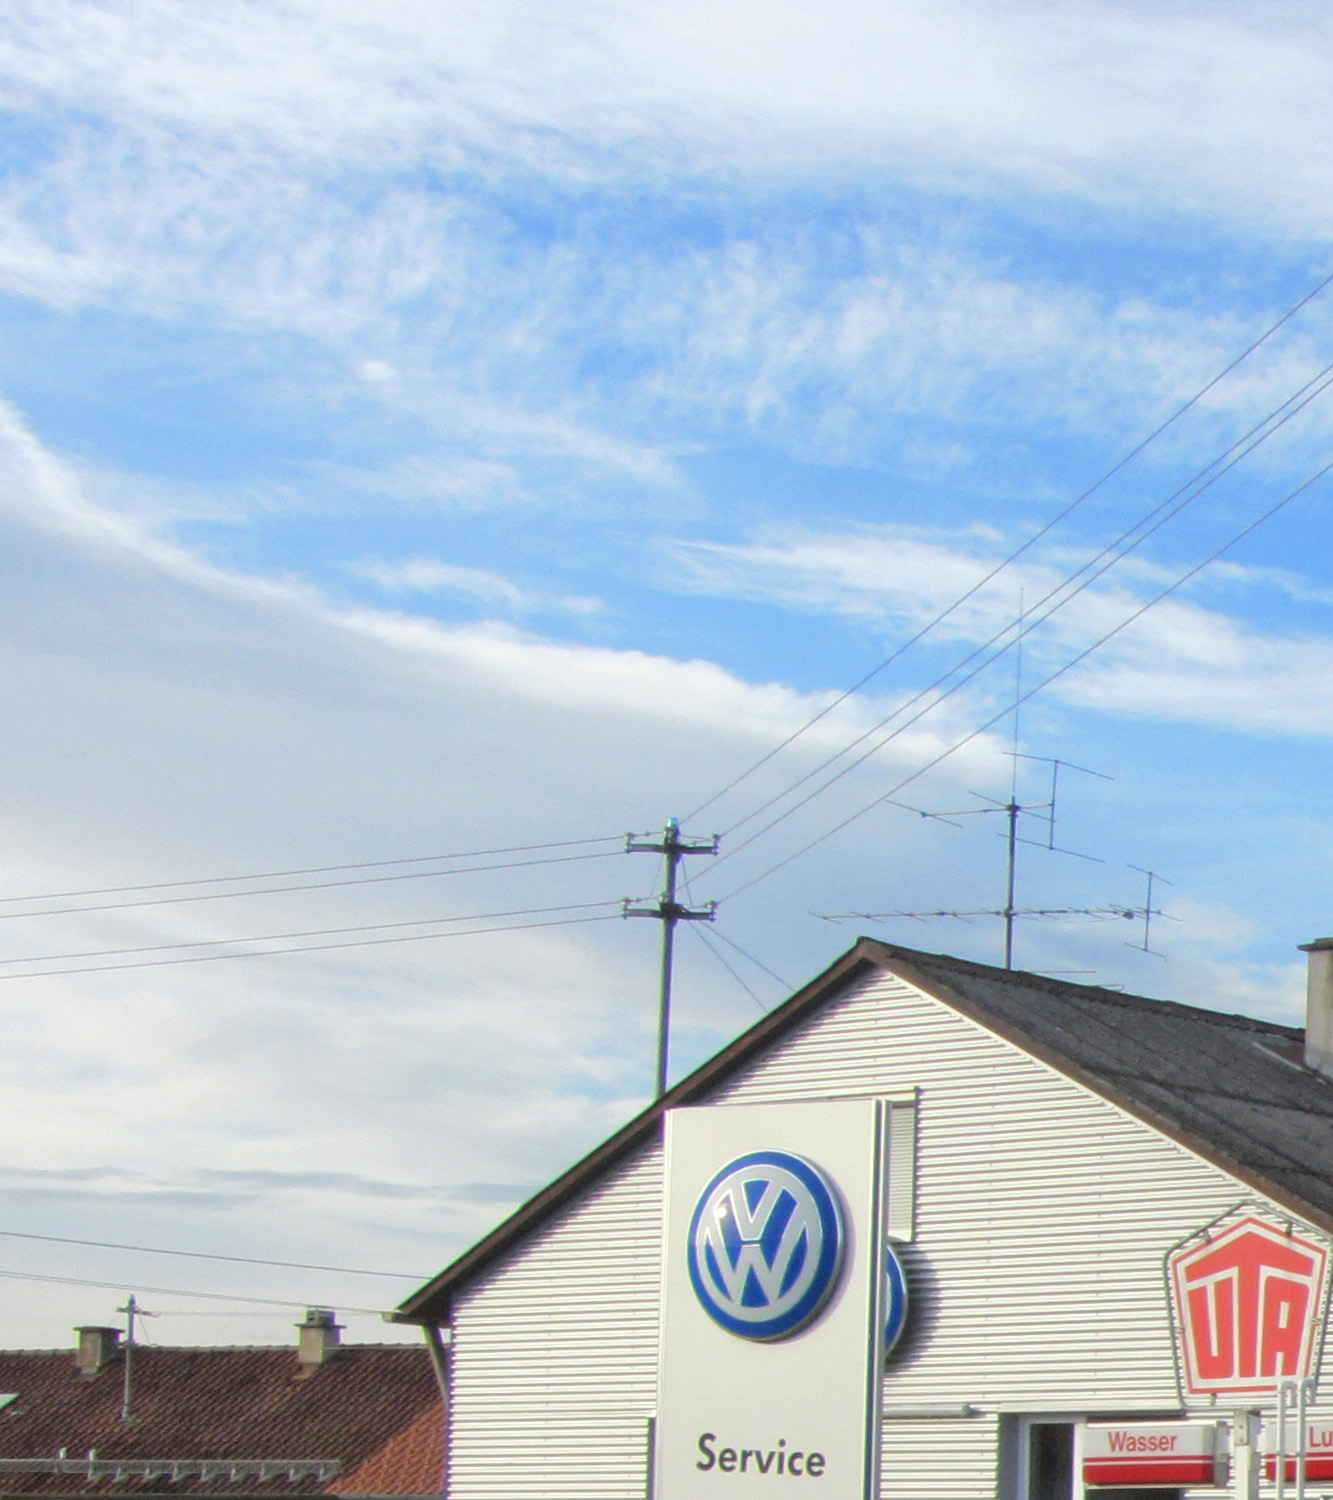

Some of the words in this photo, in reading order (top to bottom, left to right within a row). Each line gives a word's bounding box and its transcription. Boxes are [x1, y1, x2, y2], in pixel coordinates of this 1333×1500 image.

[696, 1163, 823, 1324] VW
[696, 1432, 826, 1477] Service
[1108, 1431, 1178, 1452] Wasser
